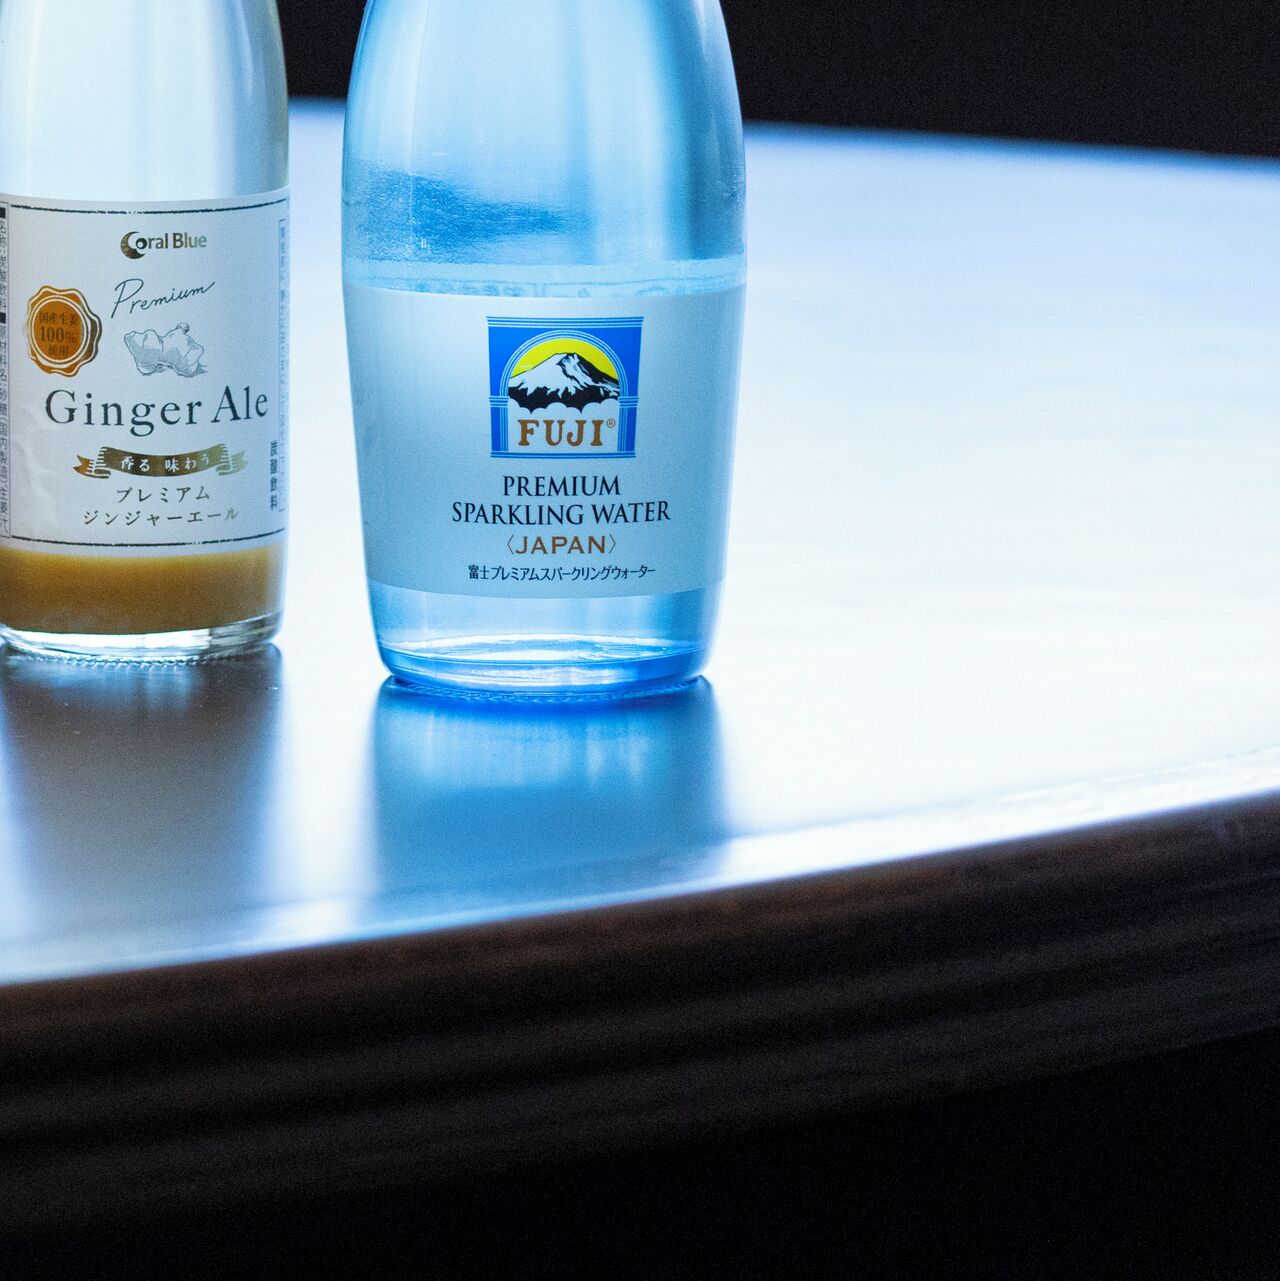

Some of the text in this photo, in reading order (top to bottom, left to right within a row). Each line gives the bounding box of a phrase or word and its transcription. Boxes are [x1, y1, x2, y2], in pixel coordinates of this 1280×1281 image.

[172, 232, 207, 250] Blue
[111, 278, 216, 318] Premium
[45, 385, 268, 437] Ginger Ale
[165, 454, 210, 472] 味わう
[117, 486, 210, 504] プレミアム
[503, 474, 621, 497] PREMIUM
[83, 507, 239, 526] ジンジャーエール
[452, 500, 671, 525] SPARKLING WATER
[468, 565, 656, 581] 富士プレミアムスパークリングウォーター
